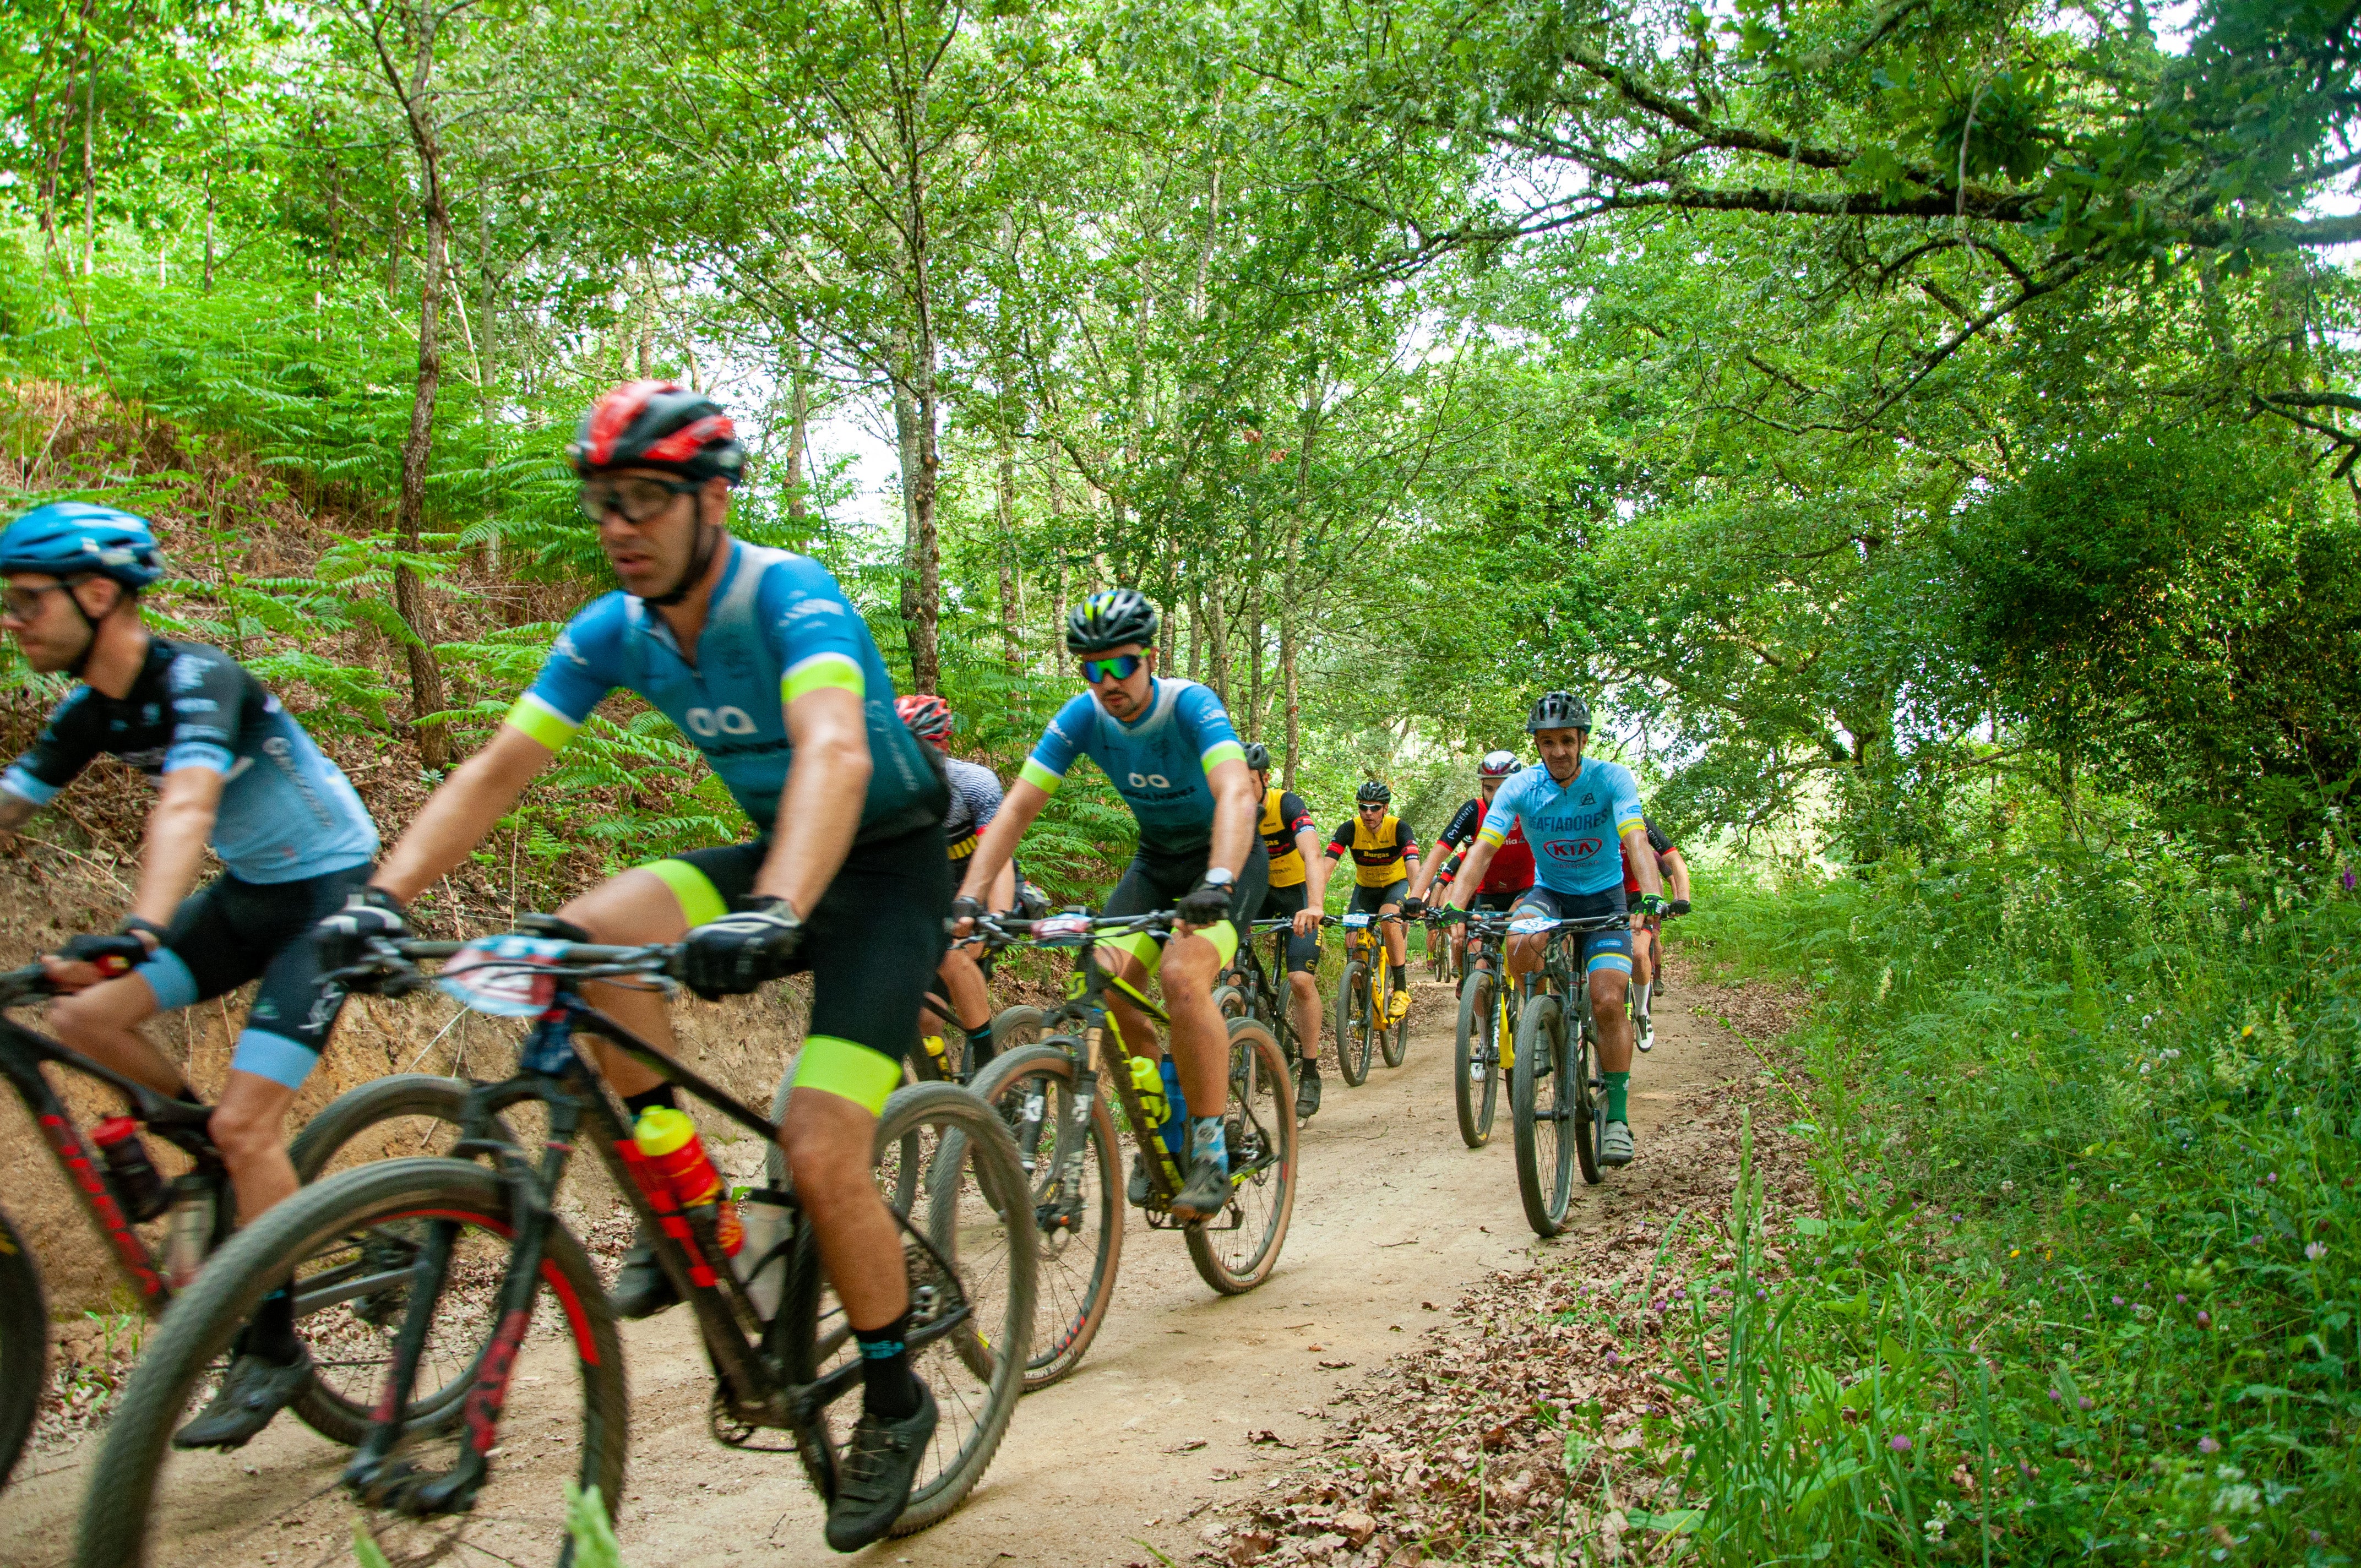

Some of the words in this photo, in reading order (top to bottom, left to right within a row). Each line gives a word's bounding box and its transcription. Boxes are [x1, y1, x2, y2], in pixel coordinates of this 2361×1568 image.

[1553, 842, 1593, 857] KIA
[1364, 851, 1390, 859] Burgas
[1523, 920, 1547, 929] 537
